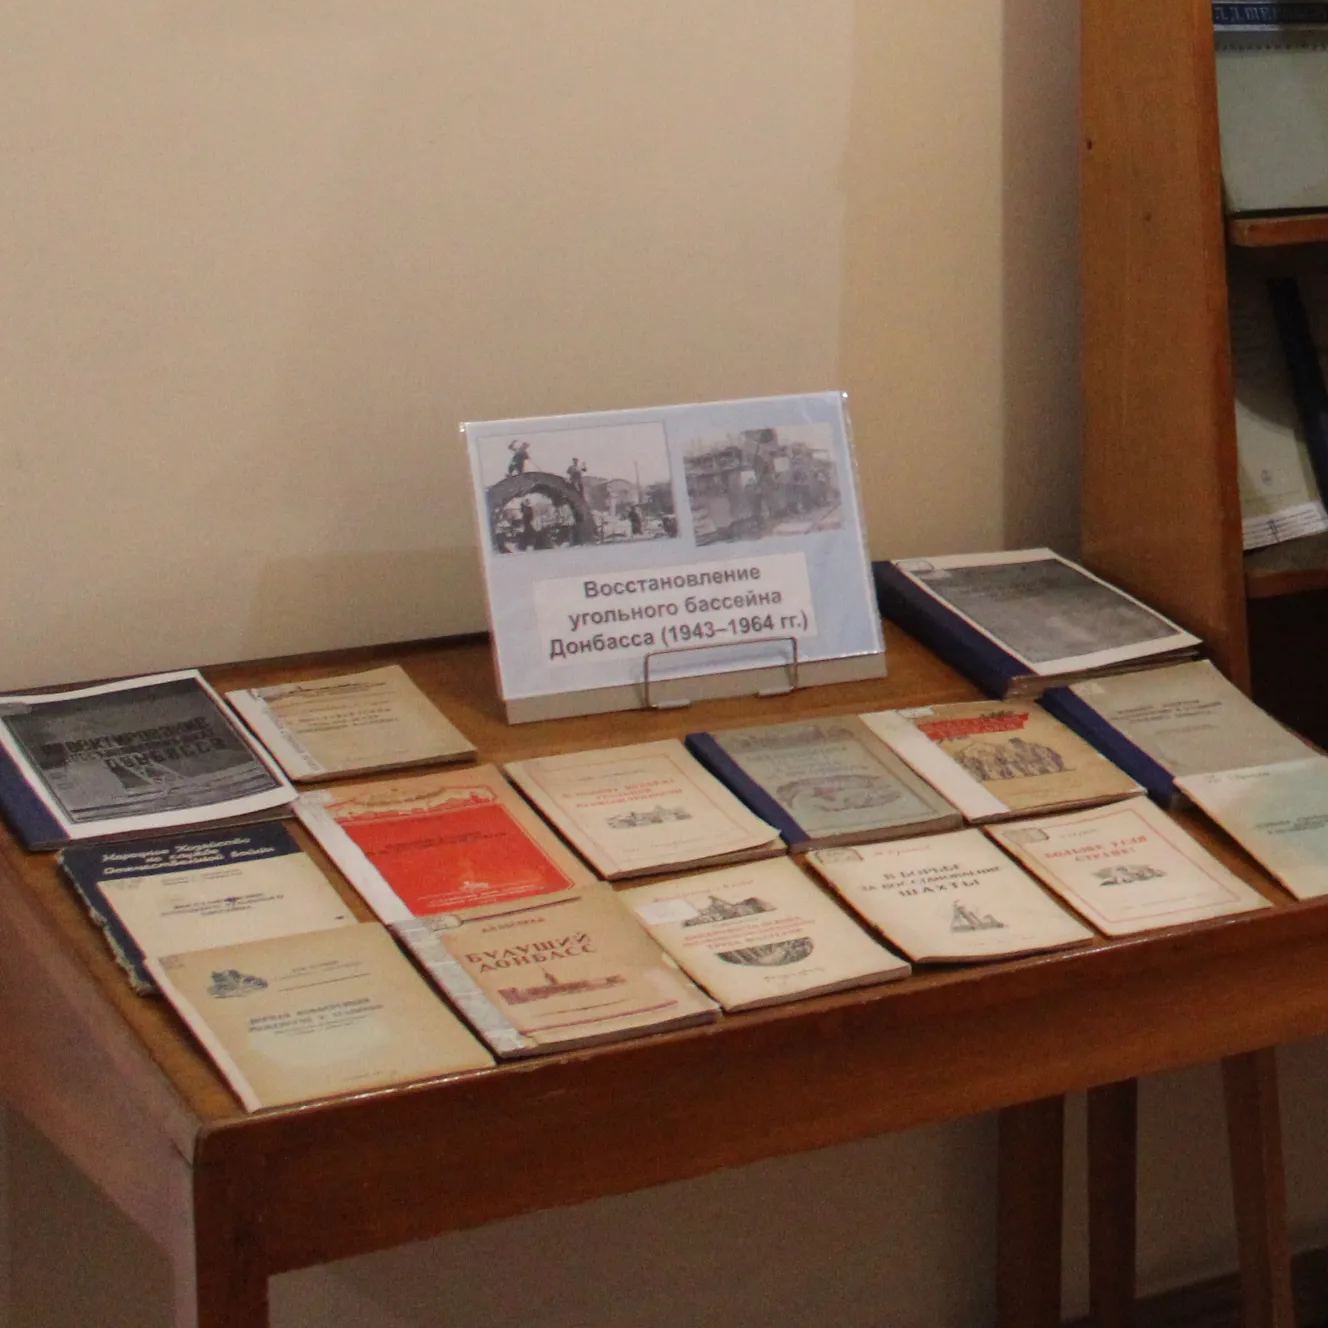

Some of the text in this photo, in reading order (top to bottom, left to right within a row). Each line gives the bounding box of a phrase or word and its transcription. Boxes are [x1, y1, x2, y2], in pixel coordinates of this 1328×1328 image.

[583, 563, 761, 599] Восстановление
[568, 588, 782, 632] угольного бассейна
[549, 624, 656, 660] Донбасса
[781, 610, 808, 634] гг.)
[898, 879, 981, 898] ШАХТЫ
[464, 930, 592, 964] БУДУЩИЙ
[479, 943, 598, 974] ДОНБАСС
